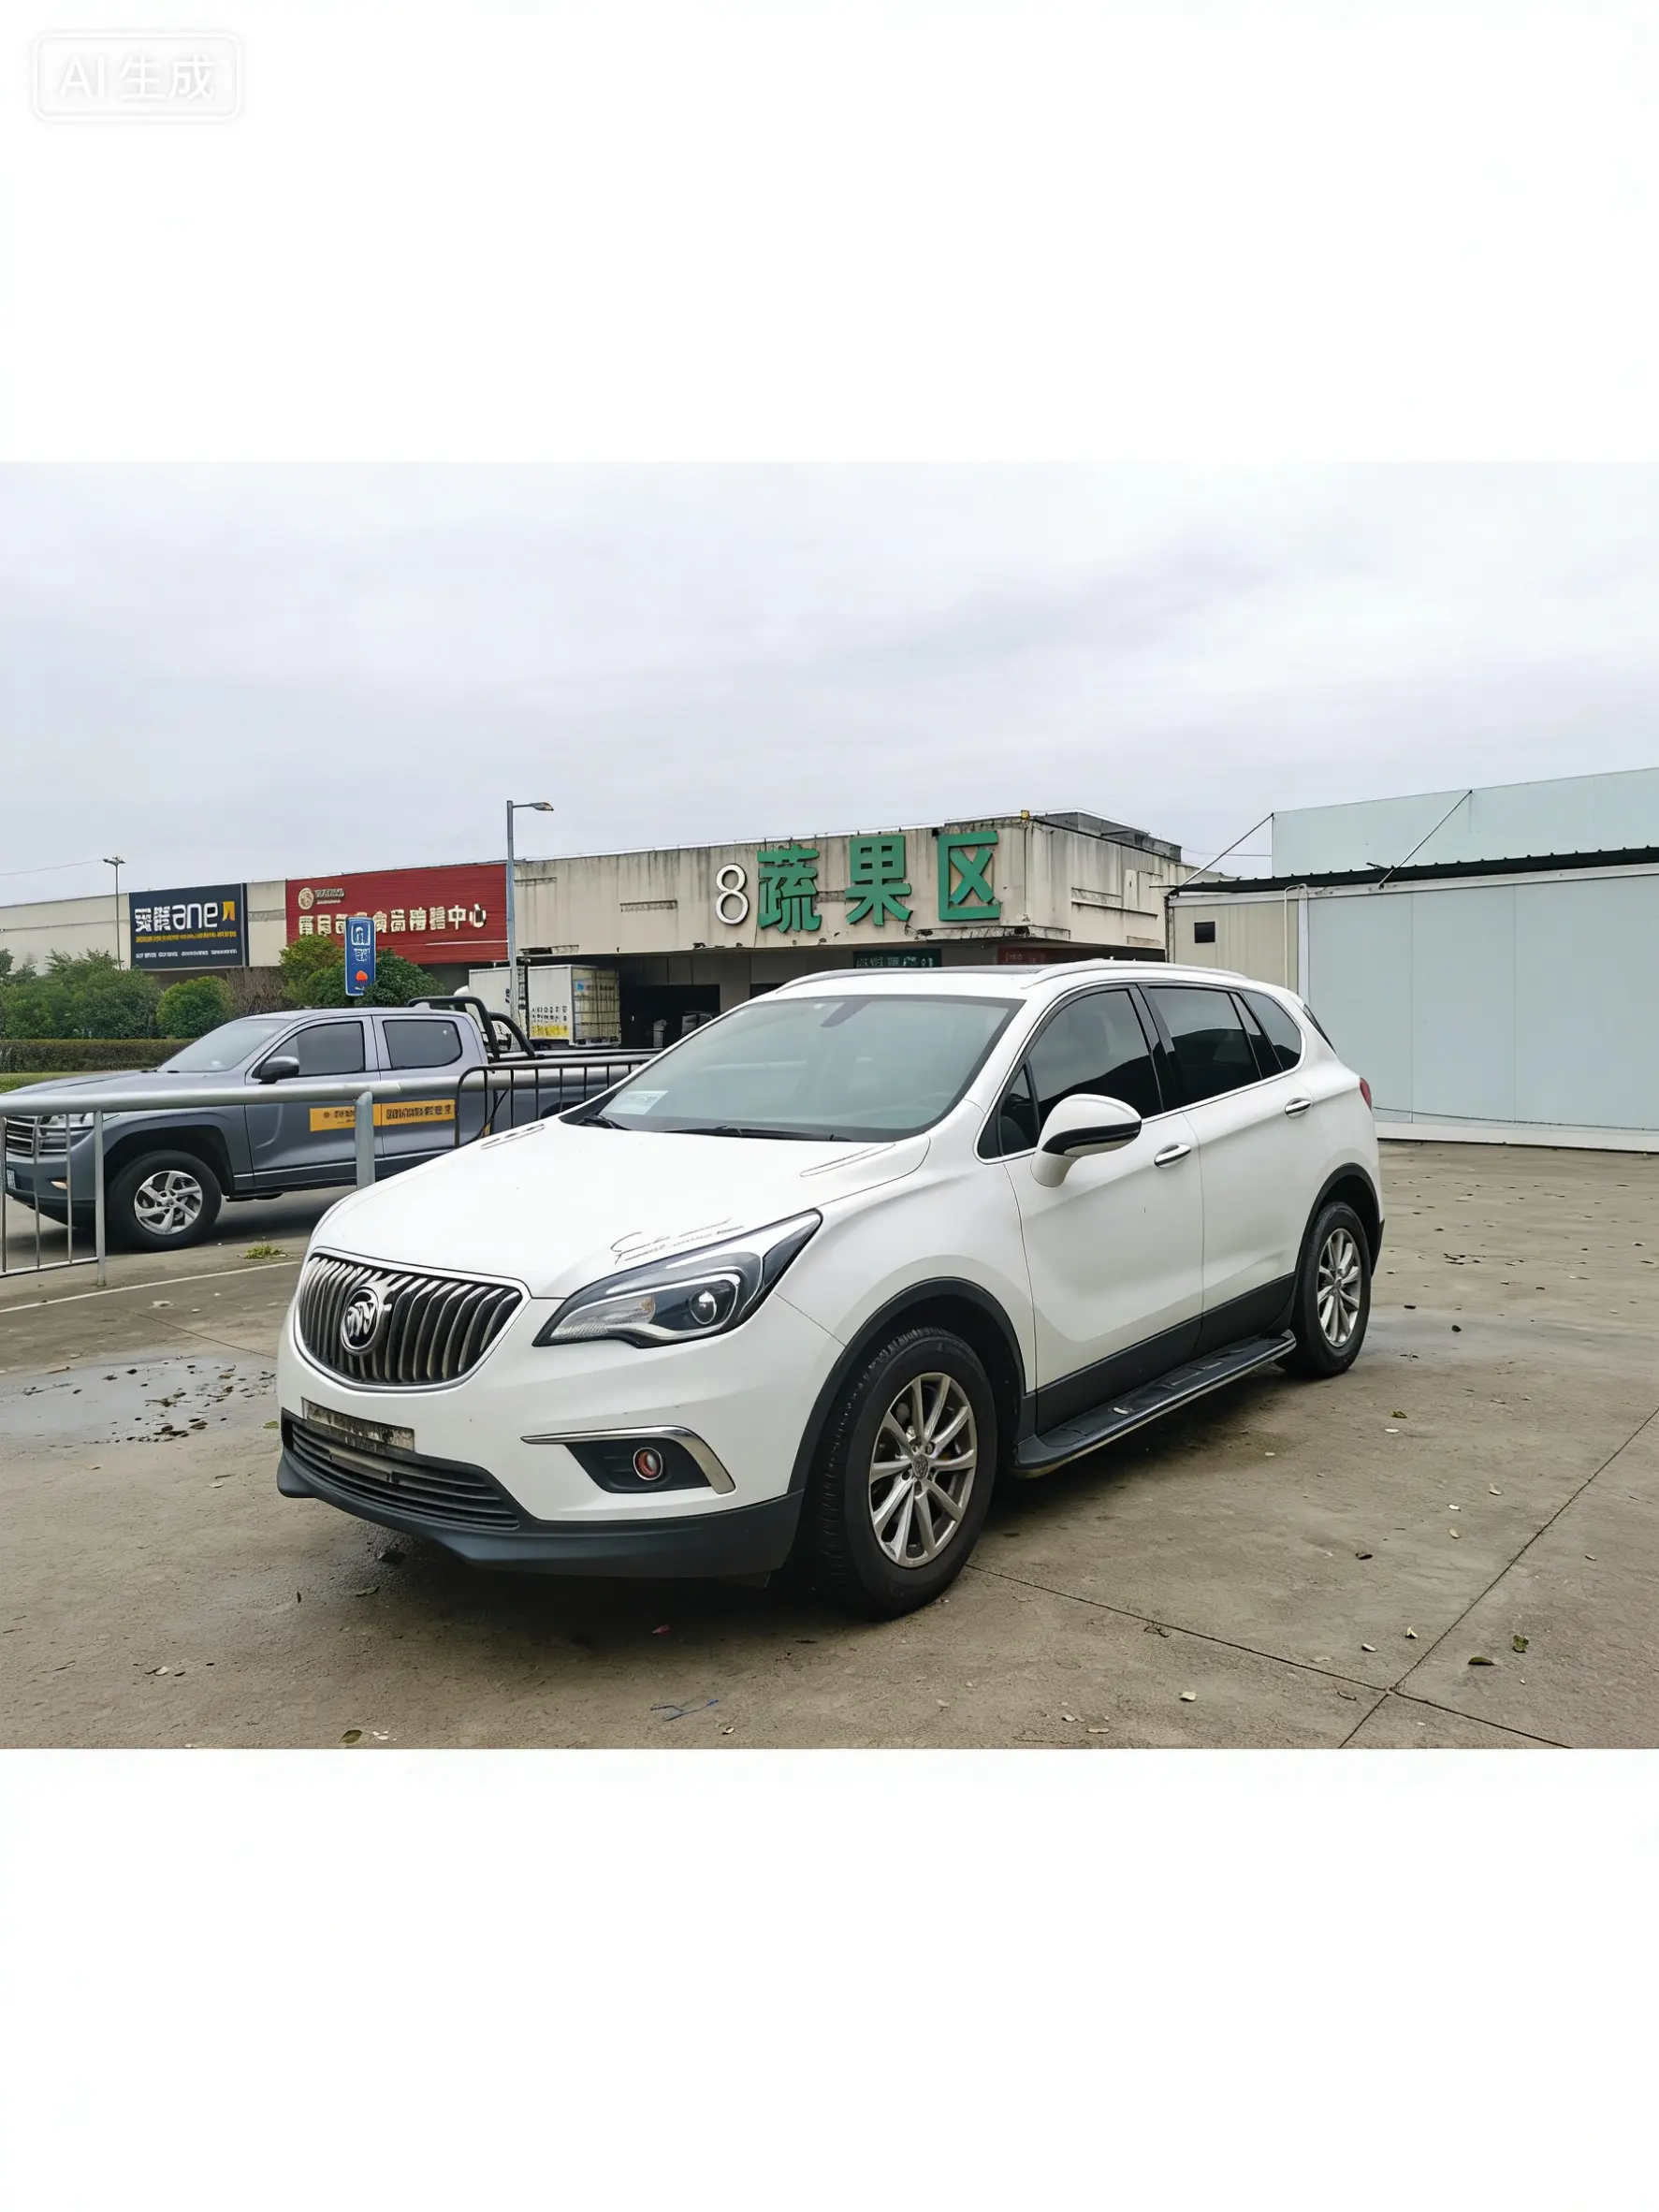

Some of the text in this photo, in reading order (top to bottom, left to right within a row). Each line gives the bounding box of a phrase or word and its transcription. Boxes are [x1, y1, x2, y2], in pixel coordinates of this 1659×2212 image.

[715, 830, 1001, 934] 8 蔬果区
